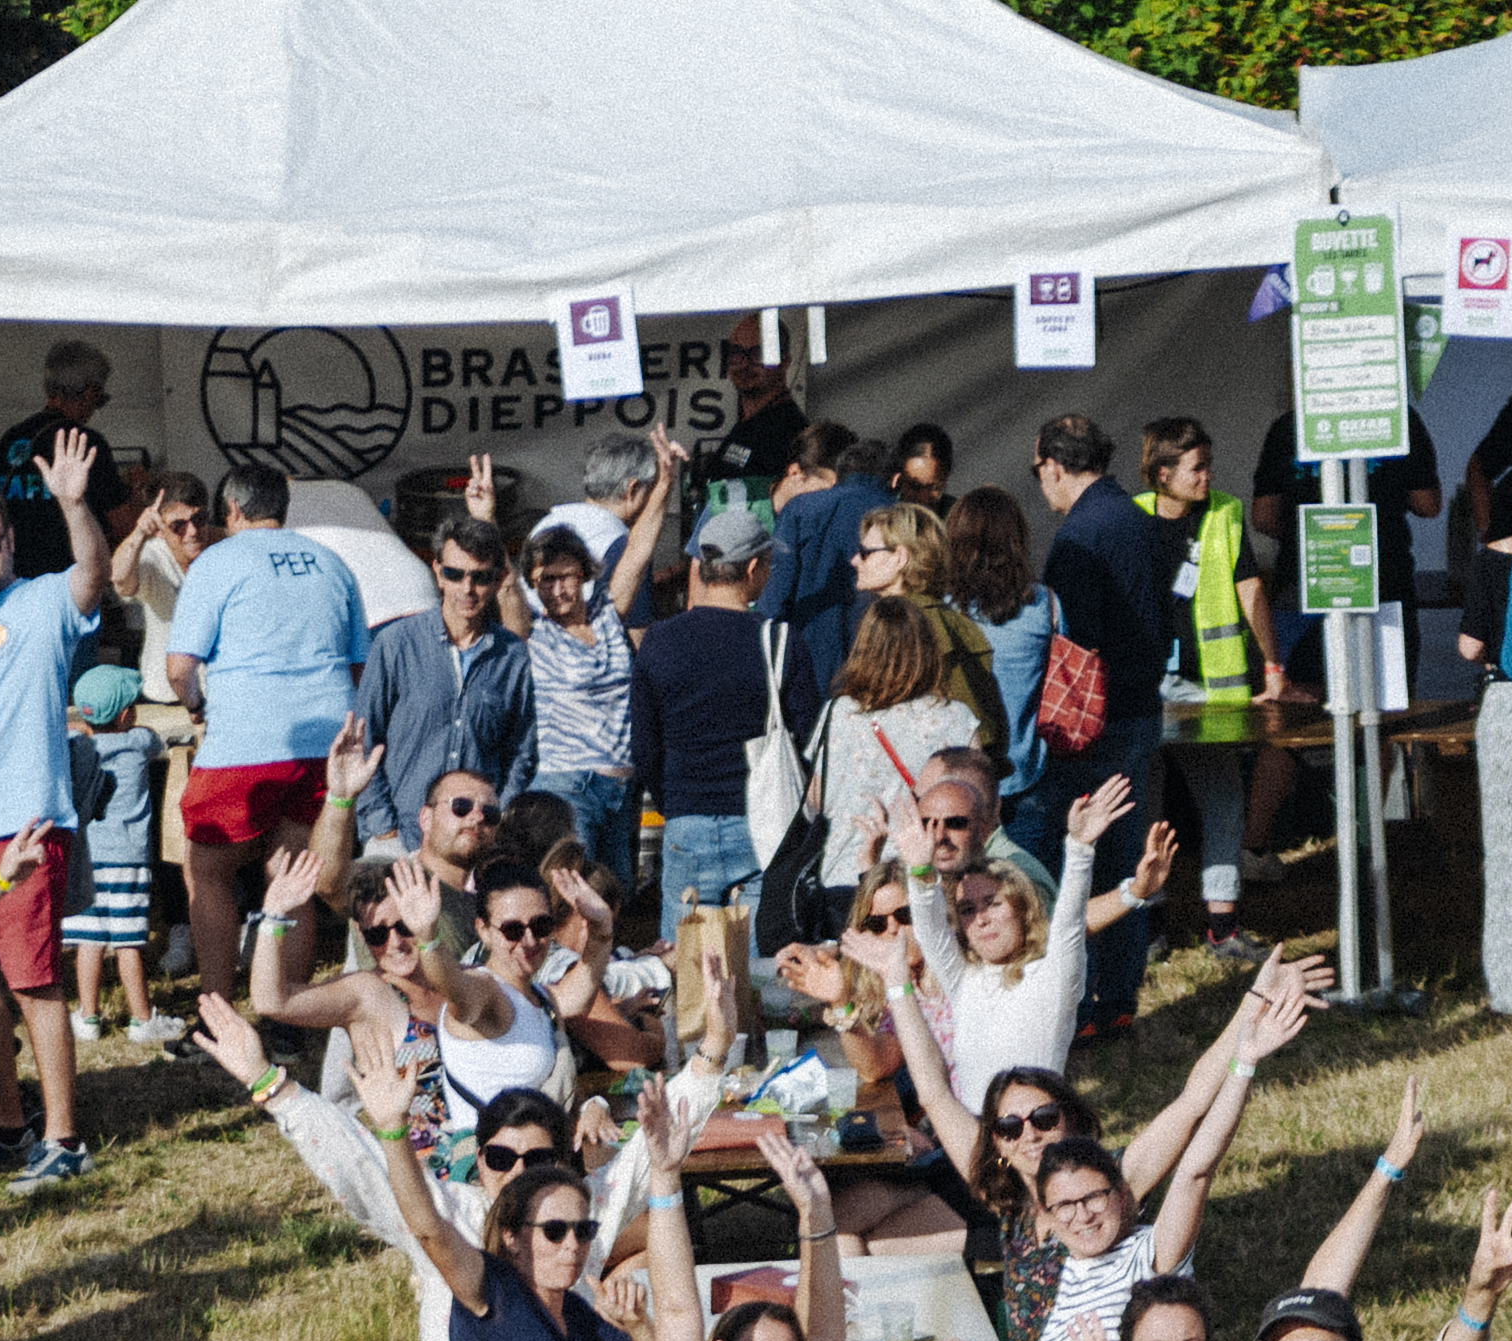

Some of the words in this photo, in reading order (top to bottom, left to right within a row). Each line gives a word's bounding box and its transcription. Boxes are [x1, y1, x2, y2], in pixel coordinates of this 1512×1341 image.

[422, 338, 733, 388] BRAERI
[422, 388, 728, 434] DIEPPOIS
[270, 552, 324, 578] PER
